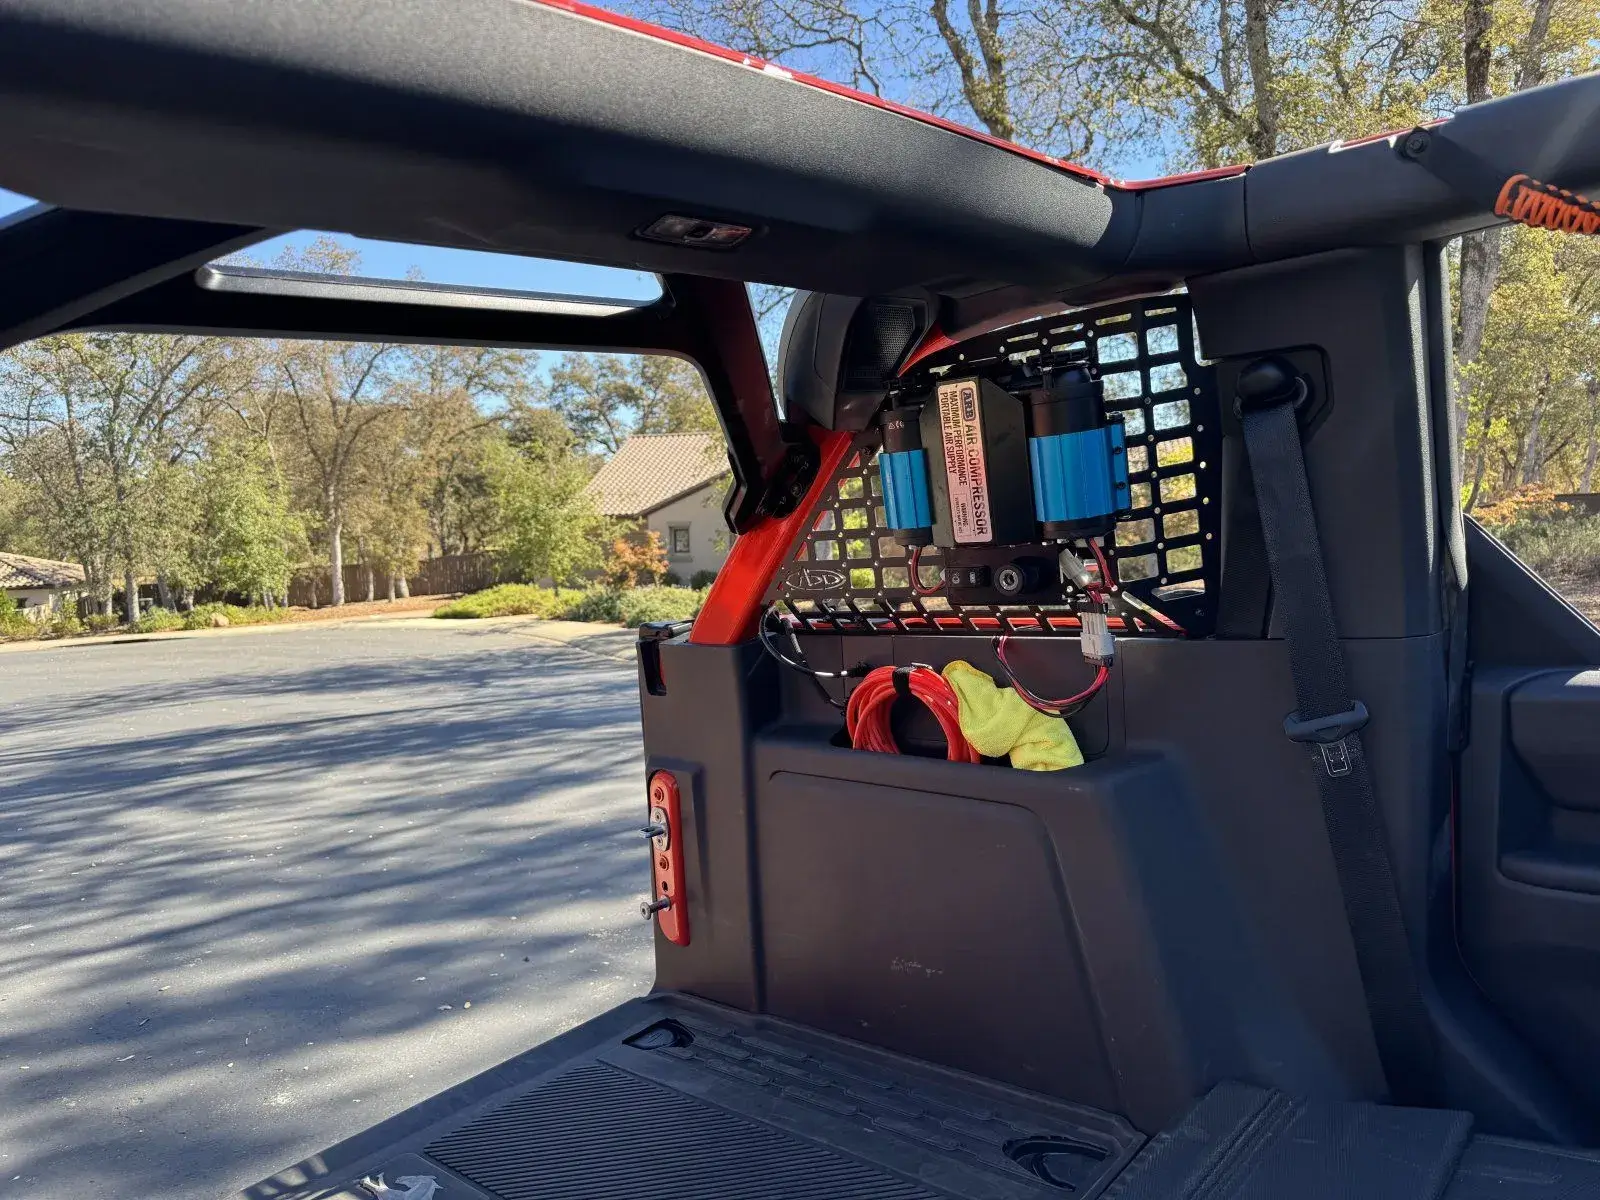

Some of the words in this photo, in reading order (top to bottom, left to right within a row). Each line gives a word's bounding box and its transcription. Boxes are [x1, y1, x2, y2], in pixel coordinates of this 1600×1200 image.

[941, 392, 952, 431] PORTABLE
[949, 390, 961, 429] MAXIMUM
[963, 391, 974, 419] ARB
[945, 432, 953, 445] AIR
[965, 424, 977, 445] AIR
[946, 445, 957, 474] SUPPLY
[953, 430, 968, 486] PERFORMANCE
[968, 448, 988, 535] COMPRESSOR
